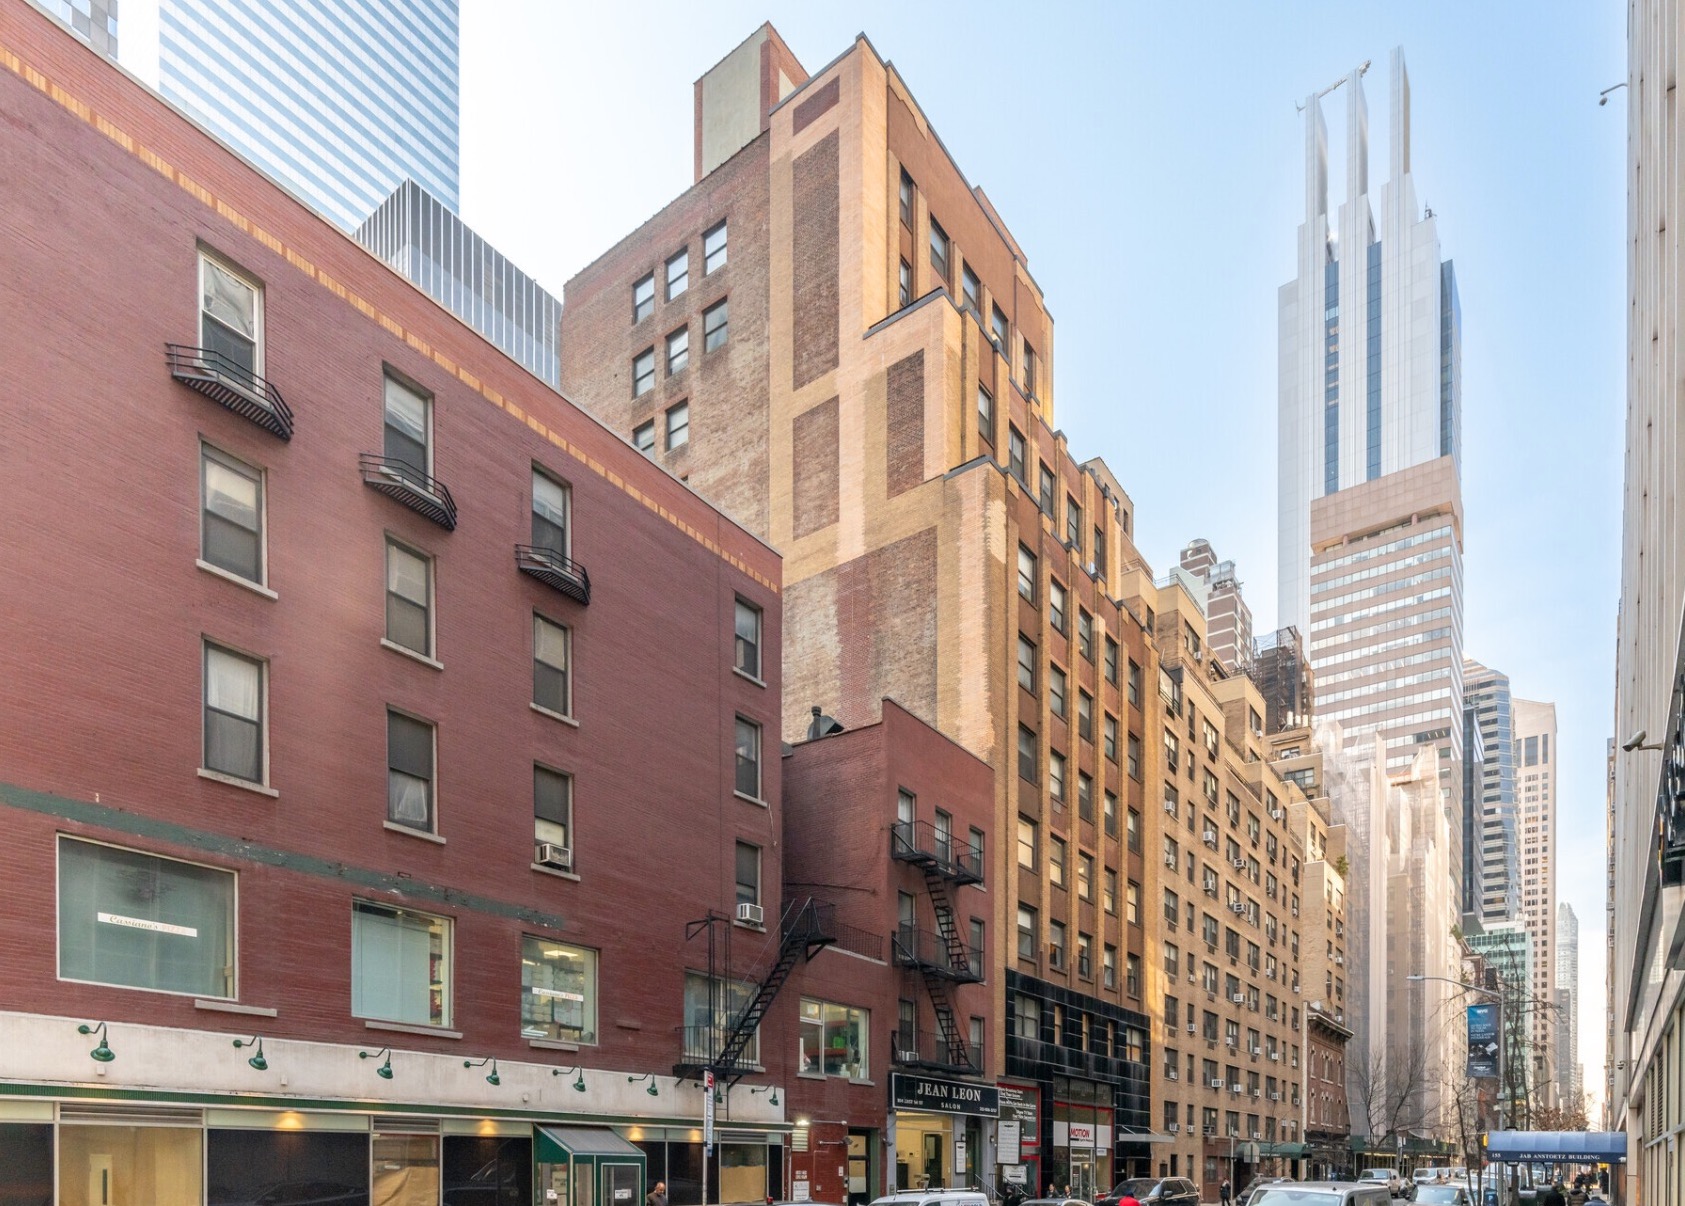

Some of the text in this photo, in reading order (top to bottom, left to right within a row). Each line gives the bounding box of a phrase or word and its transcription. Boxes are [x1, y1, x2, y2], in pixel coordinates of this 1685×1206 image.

[917, 1082, 948, 1098] JEAN
[952, 1086, 981, 1102] LEON
[940, 1102, 961, 1110] SALON
[1070, 1127, 1090, 1138] MOTION
